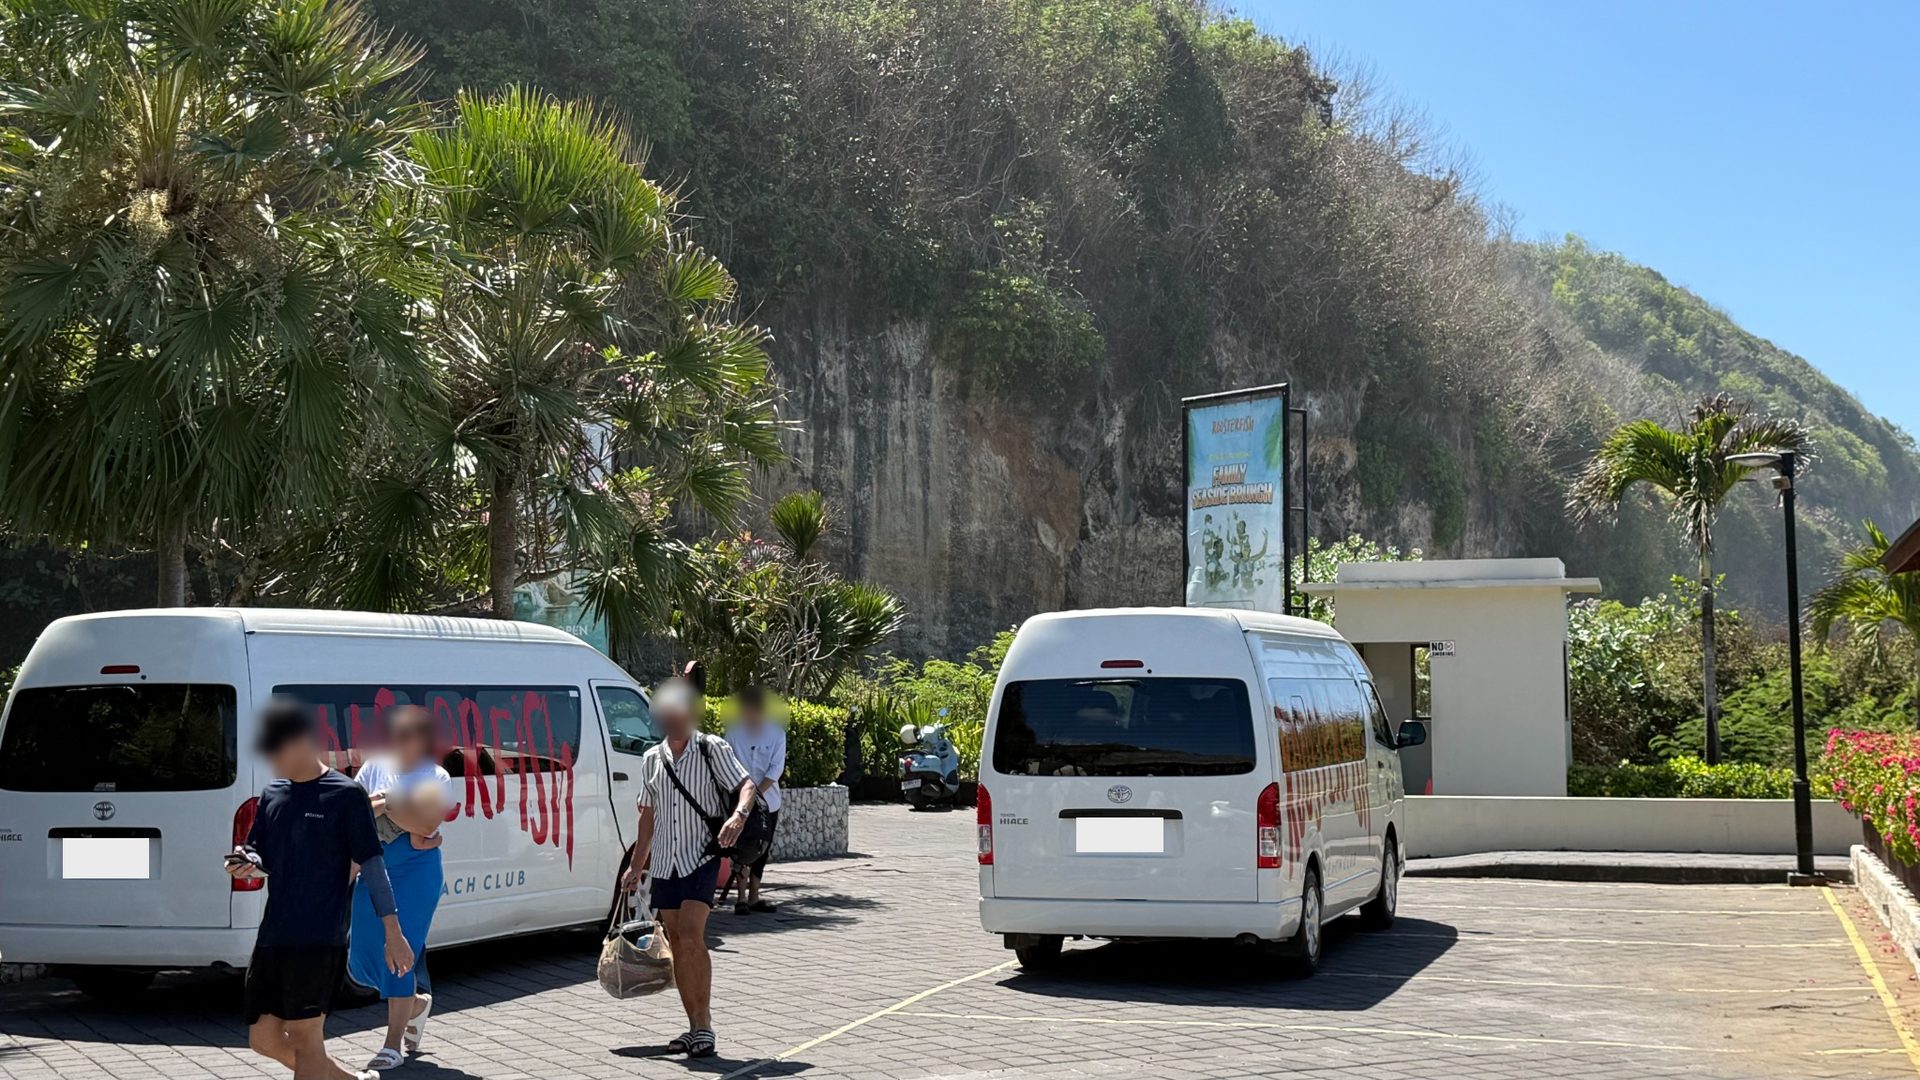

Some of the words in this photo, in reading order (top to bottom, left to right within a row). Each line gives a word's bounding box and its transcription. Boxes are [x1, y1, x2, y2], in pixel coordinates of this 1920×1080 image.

[1212, 463, 1247, 487] FAMILY
[1192, 488, 1228, 510] SEASIDE
[1229, 482, 1273, 505] BRUNCH
[1431, 642, 1444, 651] NO
[440, 877, 476, 896] ACH
[483, 870, 526, 891] CLUB
